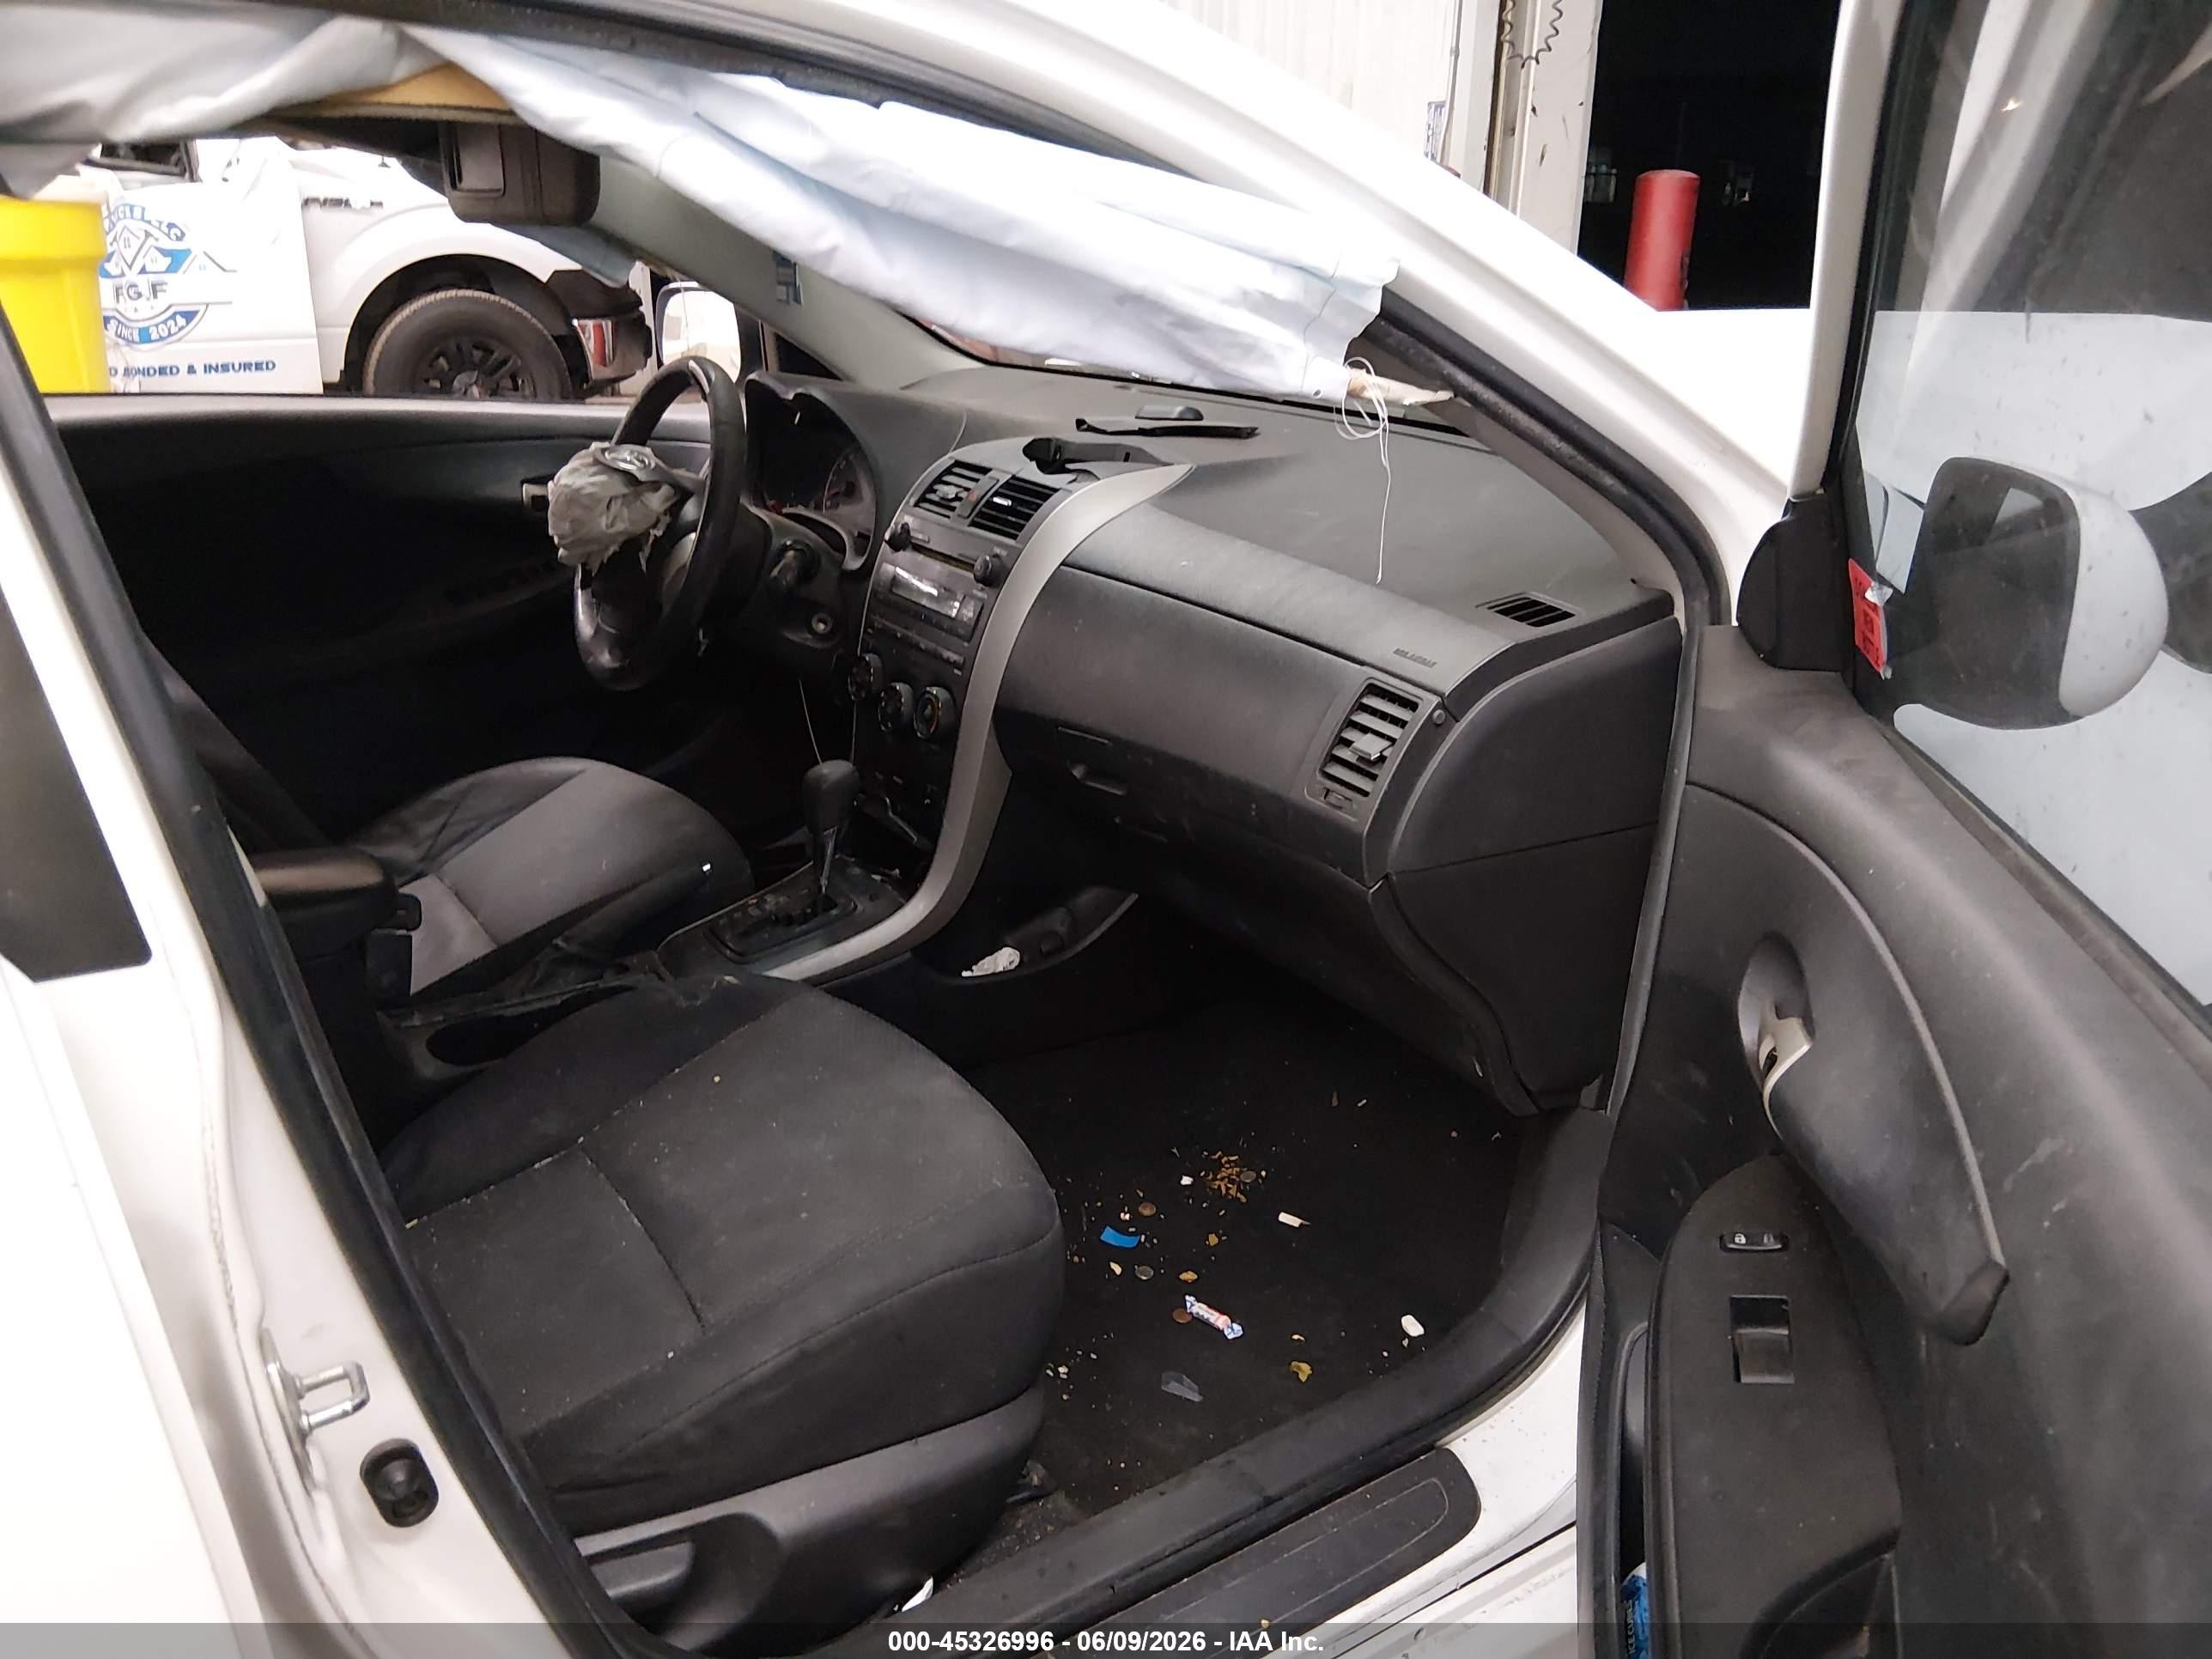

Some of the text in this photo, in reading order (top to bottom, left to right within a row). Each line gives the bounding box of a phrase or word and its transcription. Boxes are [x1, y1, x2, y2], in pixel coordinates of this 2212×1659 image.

[149, 313, 186, 341] 2024
[186, 362, 198, 375] &
[204, 360, 276, 374] INSURED
